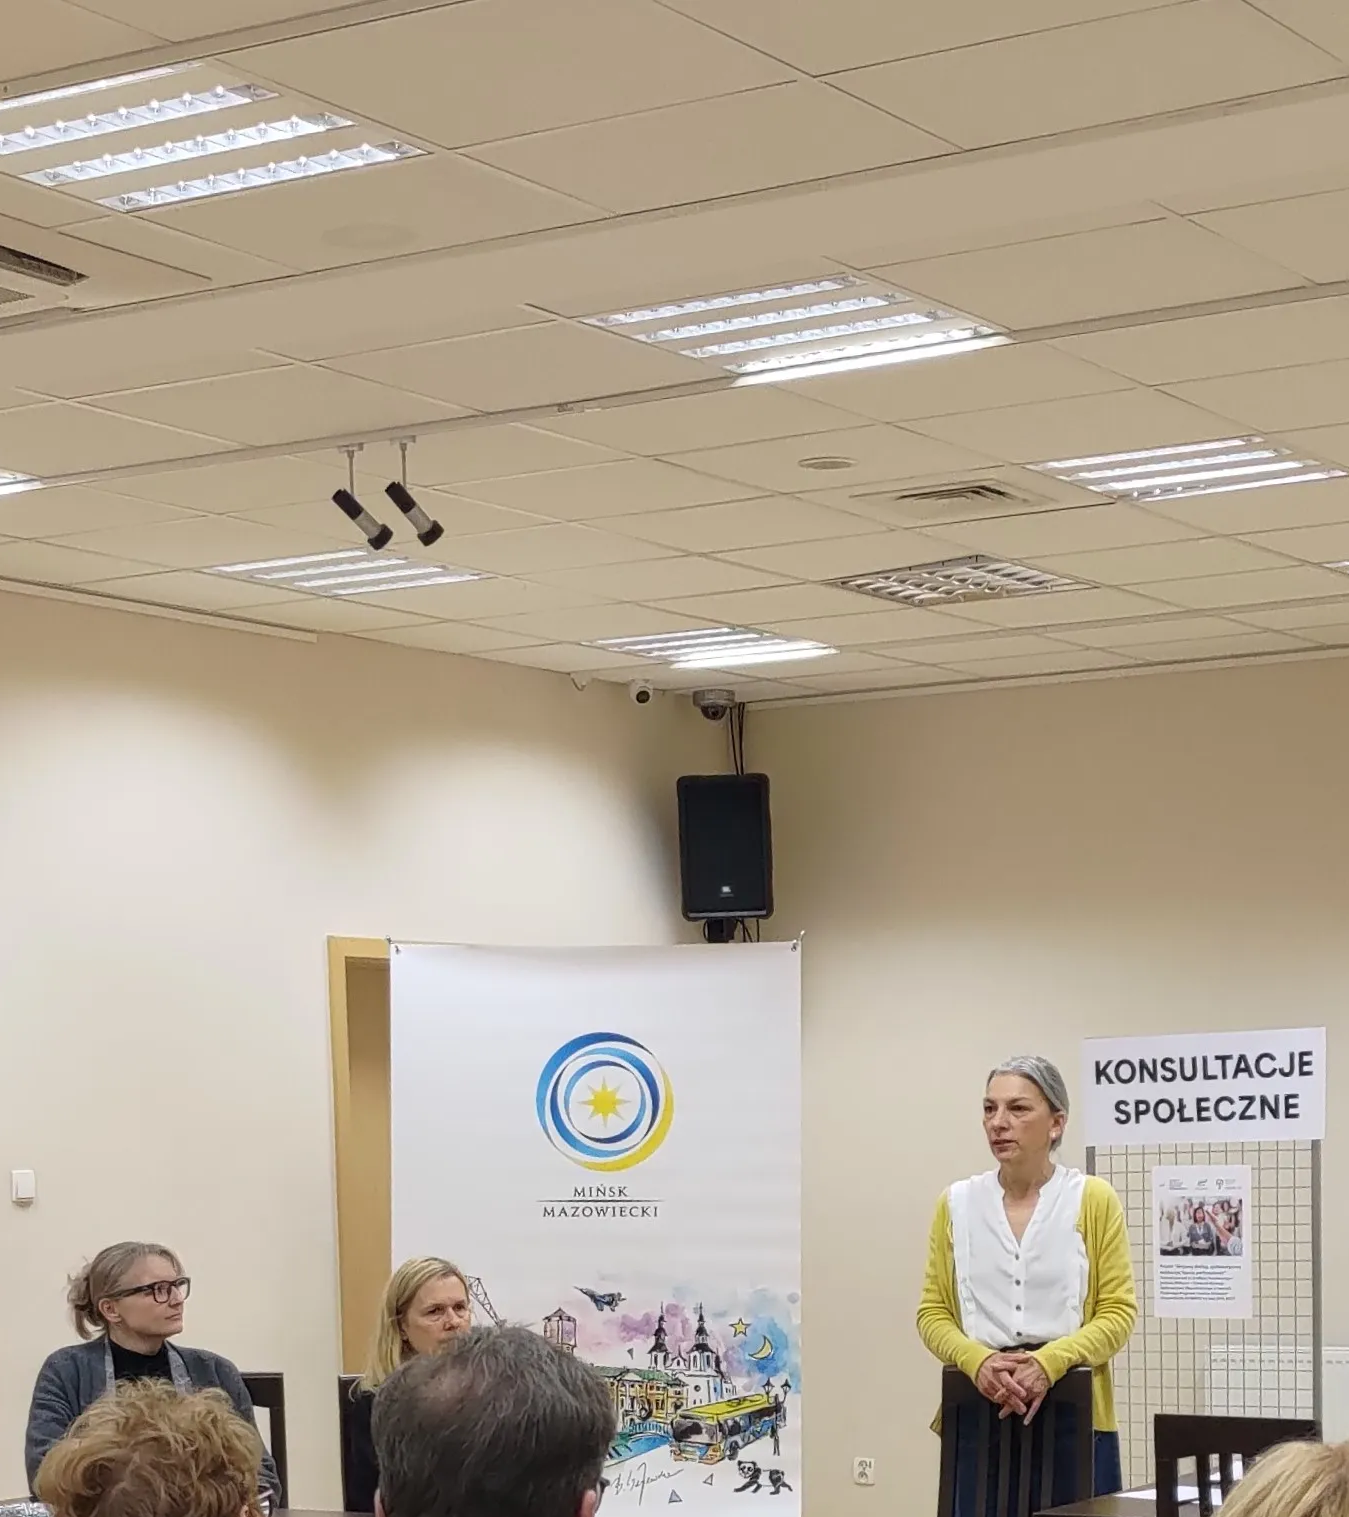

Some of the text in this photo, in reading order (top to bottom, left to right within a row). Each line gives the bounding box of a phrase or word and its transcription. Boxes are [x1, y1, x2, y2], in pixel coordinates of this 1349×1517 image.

[1094, 1050, 1314, 1086] KONSULTACJE
[1114, 1093, 1300, 1126] SPOŁECZNE
[573, 1183, 629, 1198] MIŃSK
[542, 1205, 658, 1218] MAZOWIECKI
